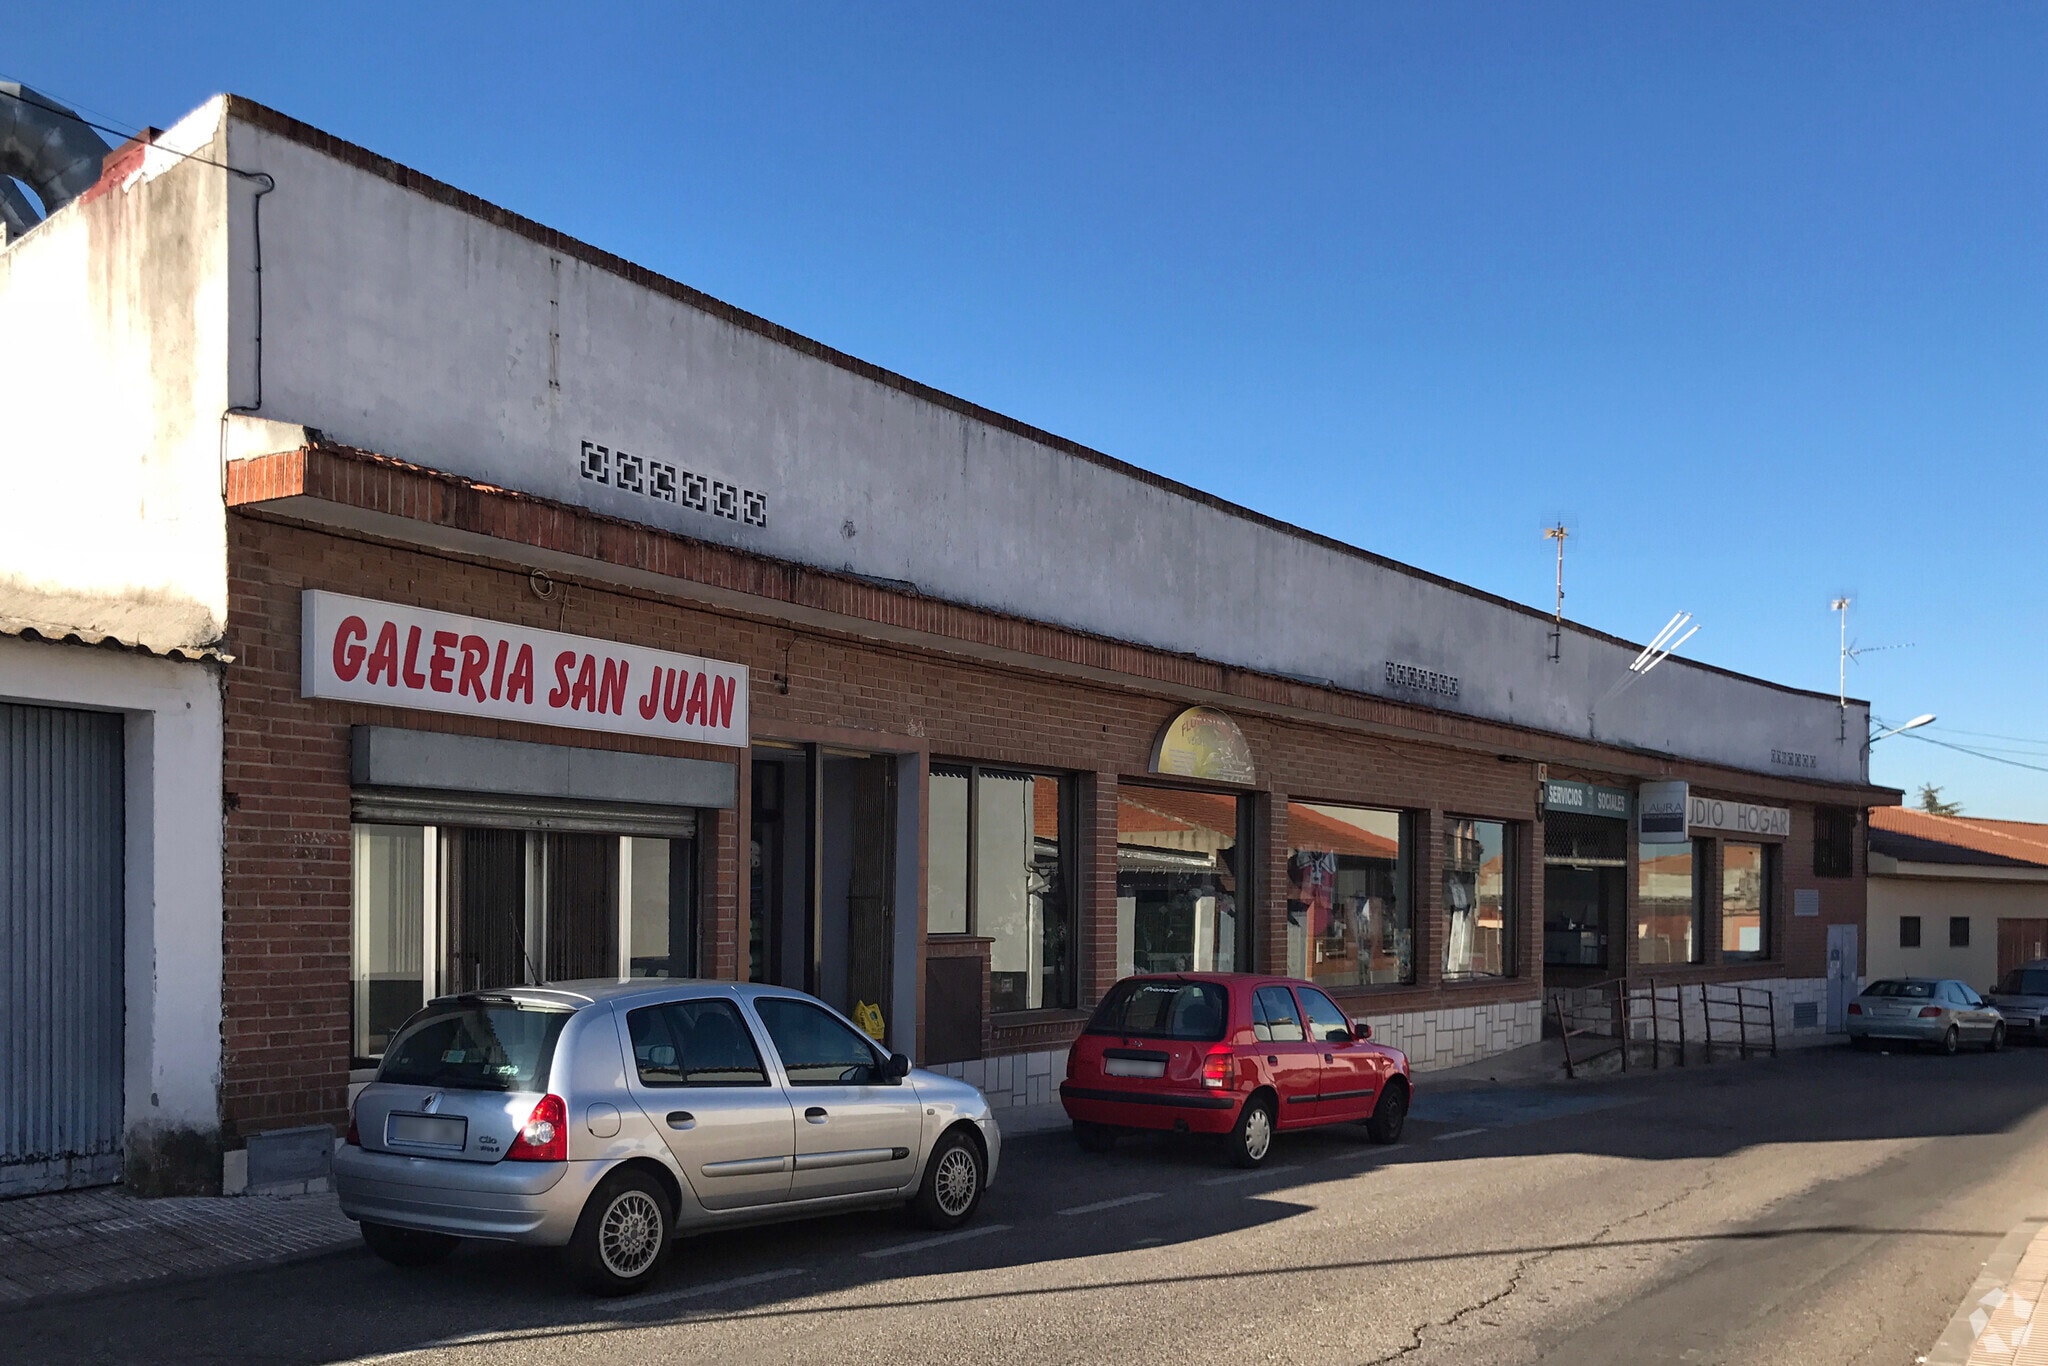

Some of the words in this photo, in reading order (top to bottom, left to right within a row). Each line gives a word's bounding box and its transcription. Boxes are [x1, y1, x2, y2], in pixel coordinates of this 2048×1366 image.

[333, 615, 533, 704] GALERIA
[549, 651, 629, 715] SAN
[639, 667, 735, 728] JUAN
[1548, 784, 1583, 807] SERVICIOS
[1597, 791, 1625, 812] SOCIALES
[1642, 802, 1684, 813] LAURA
[1738, 804, 1788, 834] HOGAR
[479, 1135, 497, 1144] Clio
